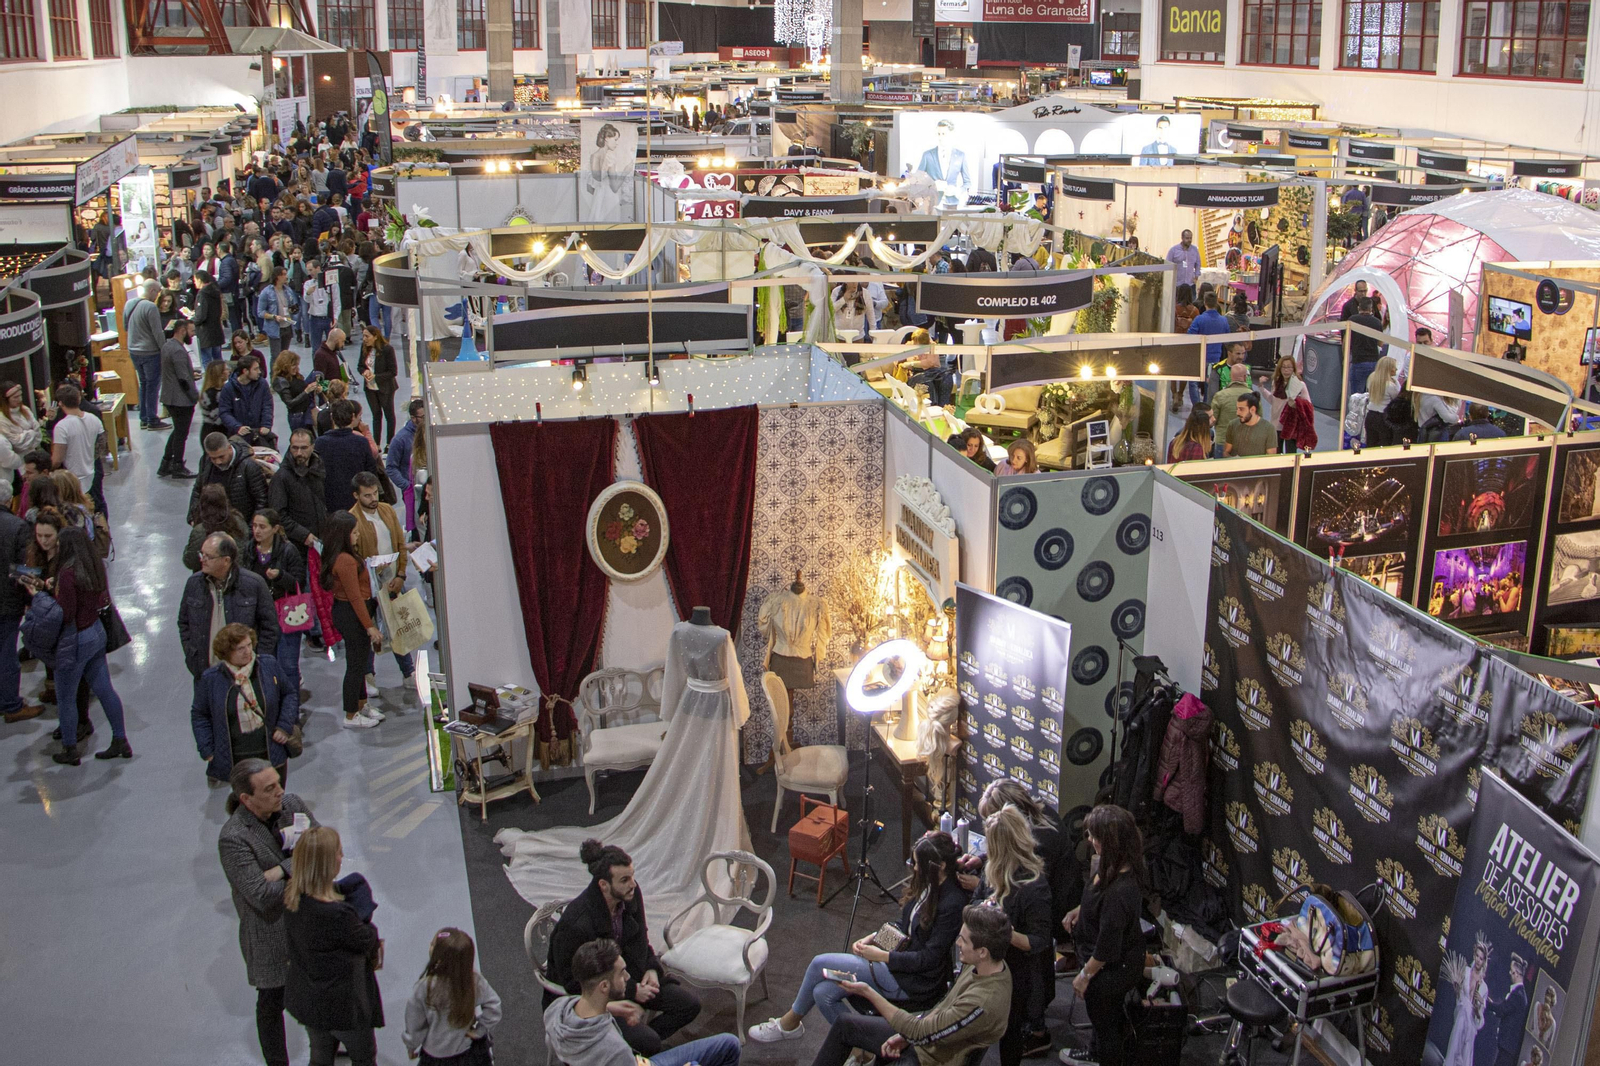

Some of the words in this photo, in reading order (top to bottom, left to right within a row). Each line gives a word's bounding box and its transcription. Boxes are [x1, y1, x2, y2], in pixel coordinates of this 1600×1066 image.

[986, 4, 1014, 15] Luna
[1018, 4, 1033, 15] de
[1037, 5, 1088, 16] Granada
[1170, 6, 1220, 33] Bankia
[745, 48, 765, 56] ASEOS
[977, 297, 1028, 307] COMPLEJO
[1030, 297, 1039, 306] EL
[1041, 295, 1056, 305] 402
[1153, 527, 1163, 541] 113
[396, 617, 421, 637] manila
[1488, 822, 1580, 923] ATELIER
[1483, 859, 1503, 890] DE
[1499, 876, 1568, 950] ASESORES
[1509, 912, 1560, 968] Medialdea
